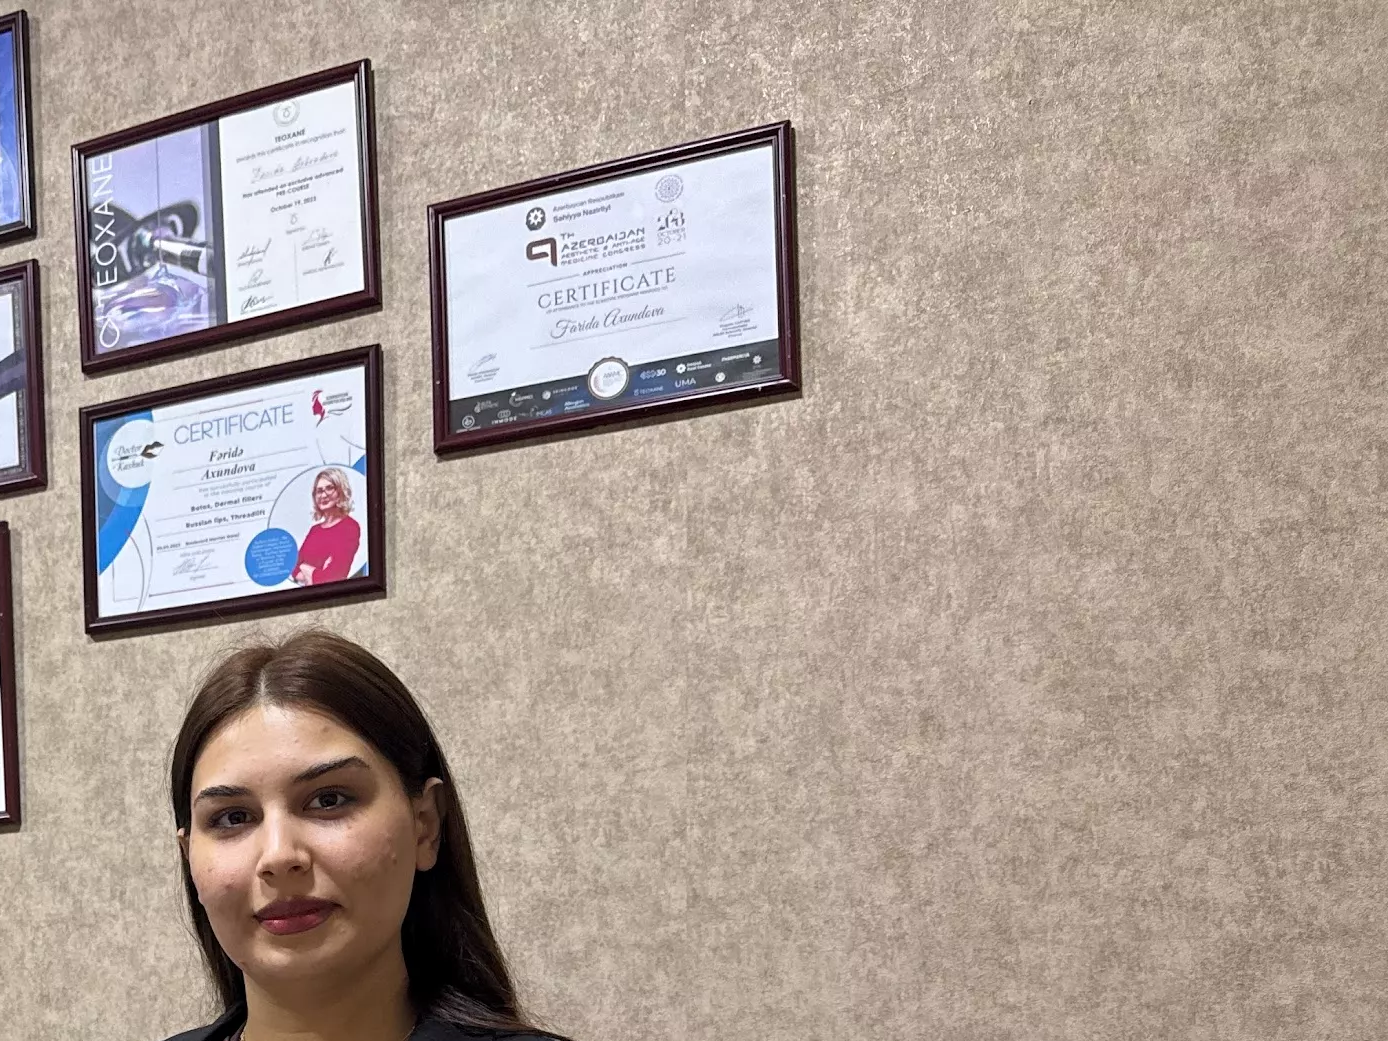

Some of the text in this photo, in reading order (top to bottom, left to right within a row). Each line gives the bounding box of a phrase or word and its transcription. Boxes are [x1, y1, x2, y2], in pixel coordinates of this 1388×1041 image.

[270, 203, 293, 213] October
[561, 227, 646, 253] AZERBAIJAN
[561, 243, 646, 266] MEDICINE CONGRESS
[582, 262, 629, 276] APPRECIATION
[537, 266, 677, 309] CERTIFICATE
[550, 303, 666, 339] Farida Axundova
[675, 378, 697, 388] UMA
[173, 403, 294, 445] CERTIFICATE
[201, 463, 256, 481] Axundova
[214, 497, 240, 509] Dermal
[230, 509, 266, 521] Threadlift
